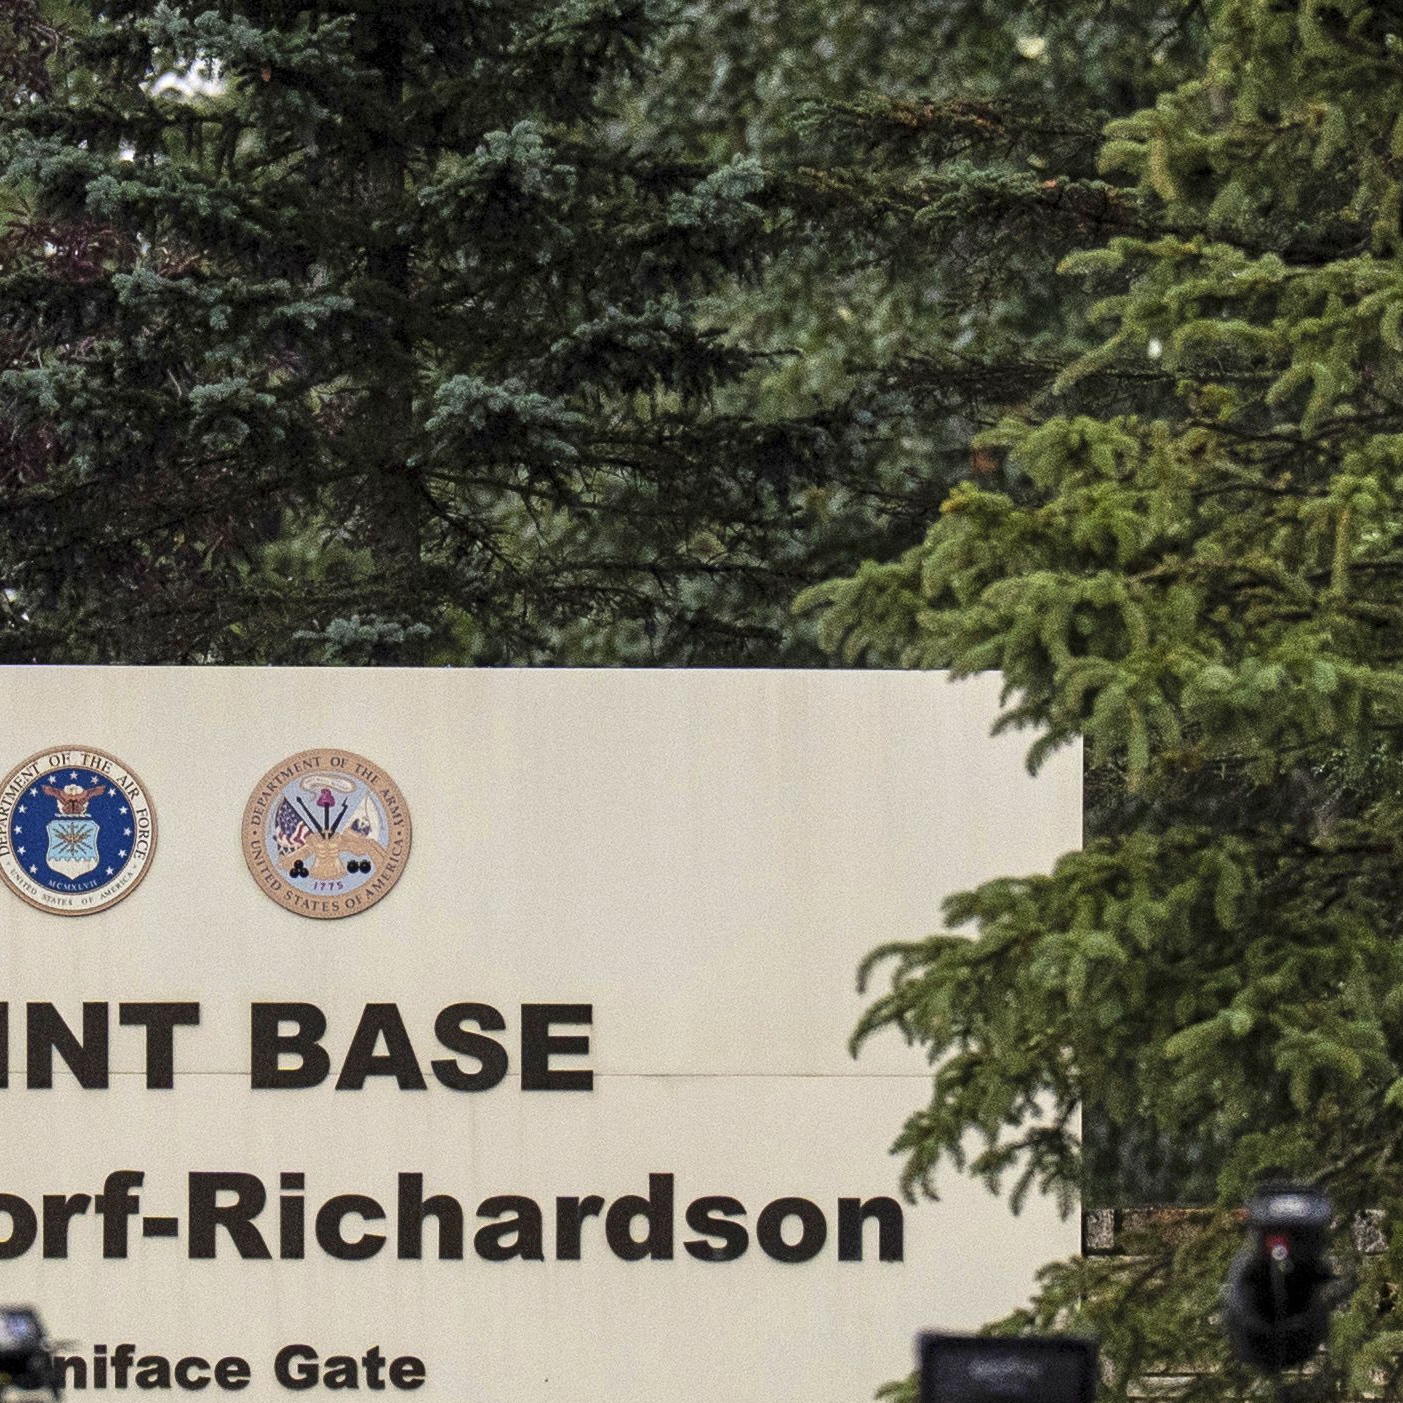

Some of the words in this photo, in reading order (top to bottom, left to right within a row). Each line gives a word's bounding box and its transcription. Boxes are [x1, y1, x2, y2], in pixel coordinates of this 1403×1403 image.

[49, 753, 71, 766] OF
[82, 753, 112, 773] THE
[116, 775, 139, 800] AIR
[135, 809, 150, 861] FORCE
[251, 756, 321, 826] DEPARTMENT
[330, 756, 347, 769] OF
[355, 763, 381, 786] THE
[380, 789, 405, 826] ARMY
[10, 868, 38, 895] UNITED
[42, 893, 73, 906] STATES
[81, 896, 93, 905] OF
[100, 871, 134, 900] AMERICA
[48, 879, 98, 891] MCMXLVII
[251, 840, 282, 892] UNITED
[284, 890, 340, 913] STATES
[345, 894, 364, 909] OF
[366, 839, 404, 900] AMERICA
[313, 881, 344, 891] 1775
[250, 1002, 594, 1092] BASE
[52, 1343, 251, 1391] niface
[274, 1344, 426, 1391] Gate
